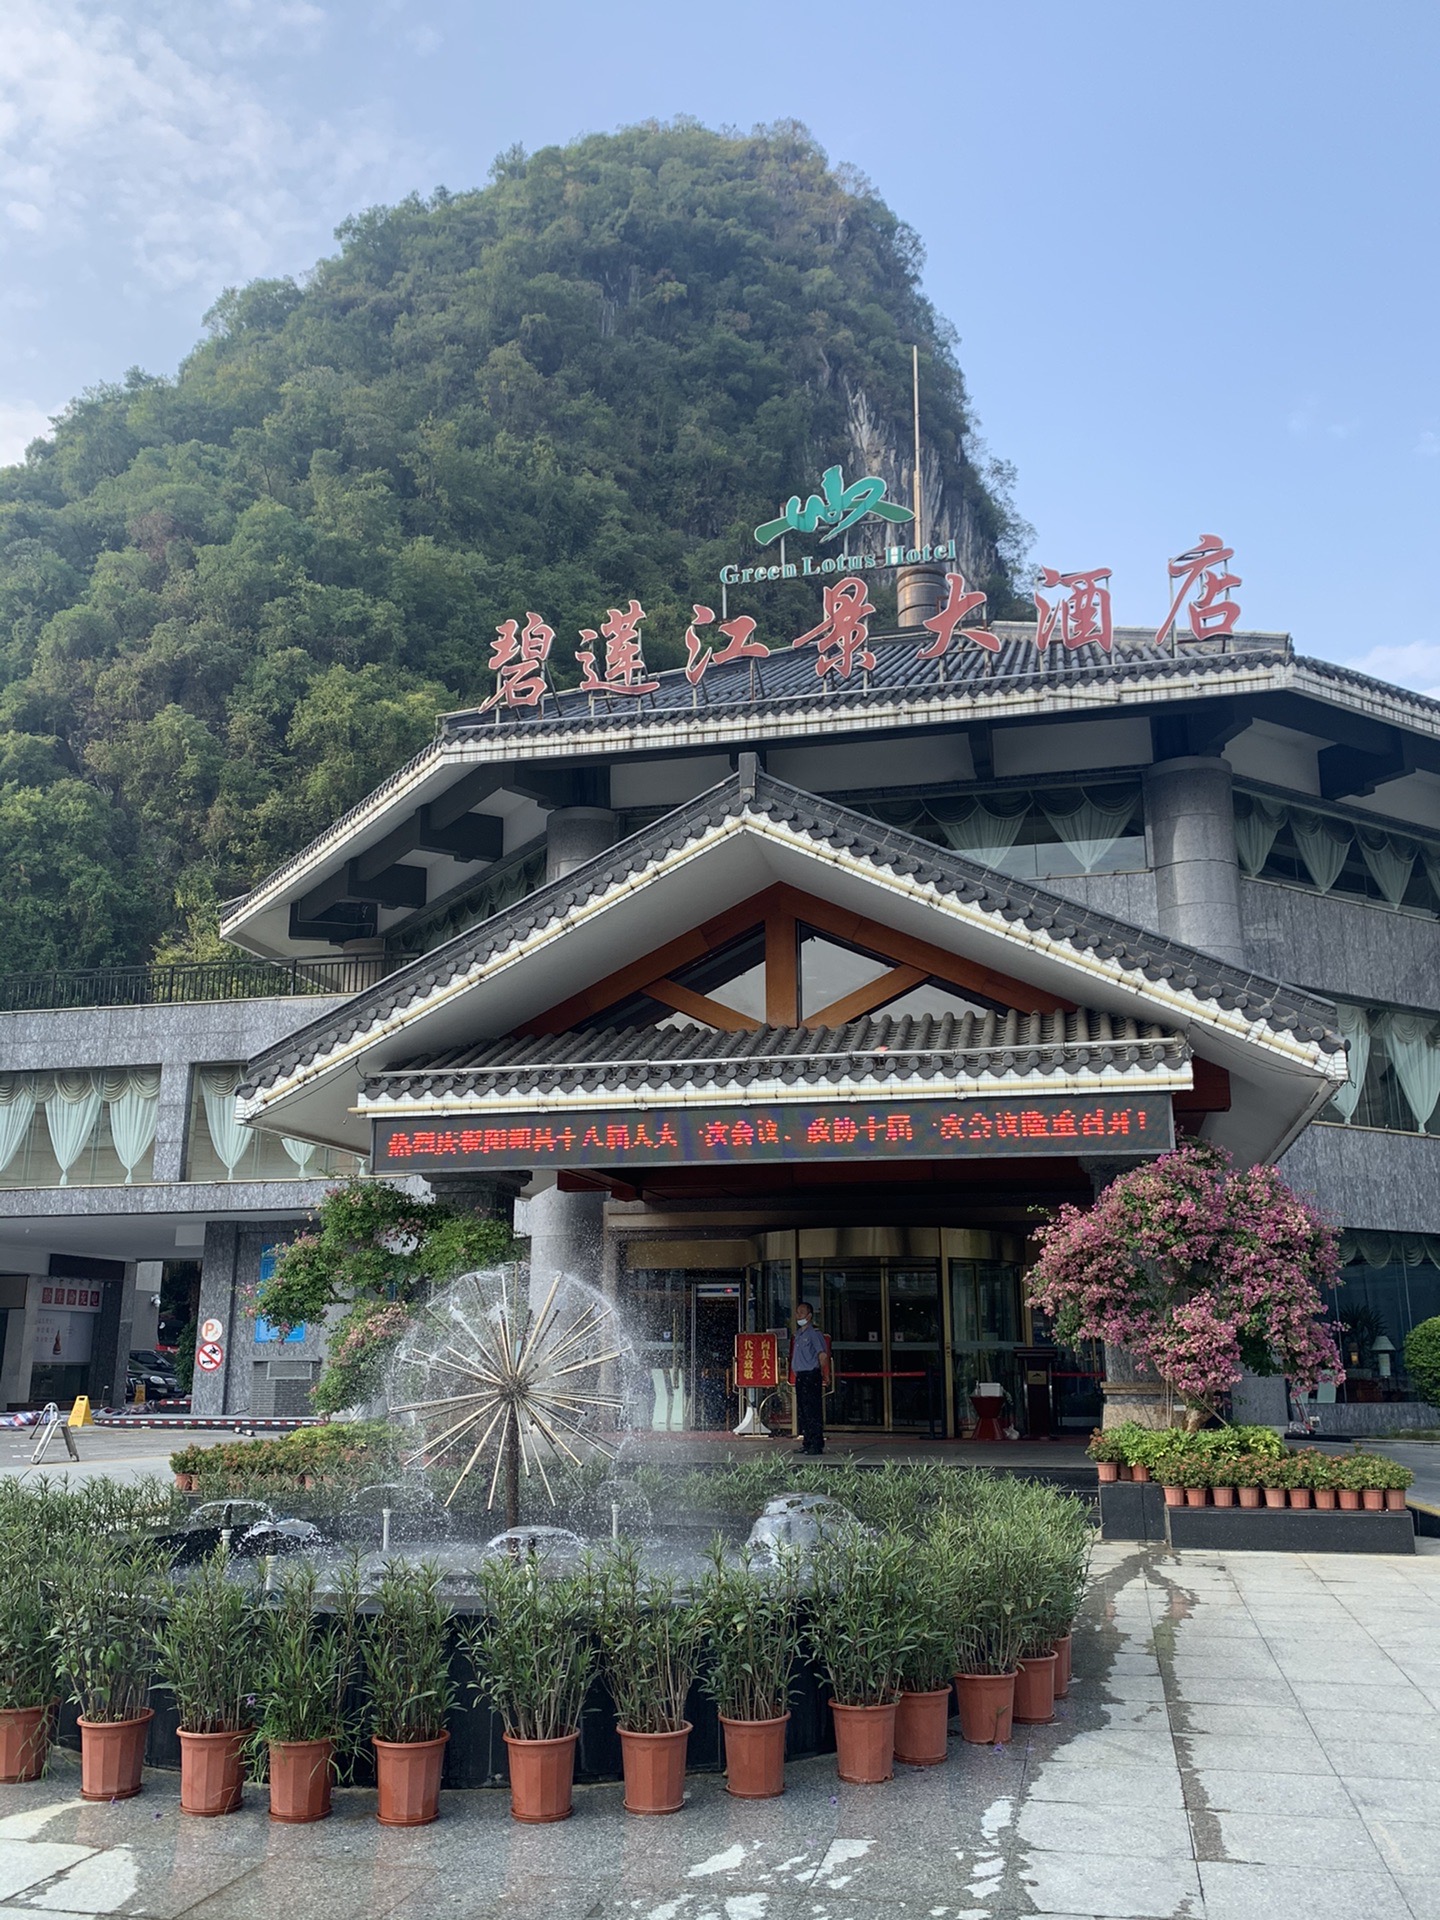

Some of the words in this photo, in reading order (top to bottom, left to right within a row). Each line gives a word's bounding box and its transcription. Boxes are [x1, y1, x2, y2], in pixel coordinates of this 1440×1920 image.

[719, 563, 797, 585] Green
[802, 553, 877, 577] Lotus
[885, 539, 957, 566] Hotel
[478, 533, 1242, 714] 碧莲江景大酒店
[204, 1322, 215, 1337] P
[743, 1339, 754, 1380] 代表致敬
[760, 1338, 771, 1379] 向县人大
